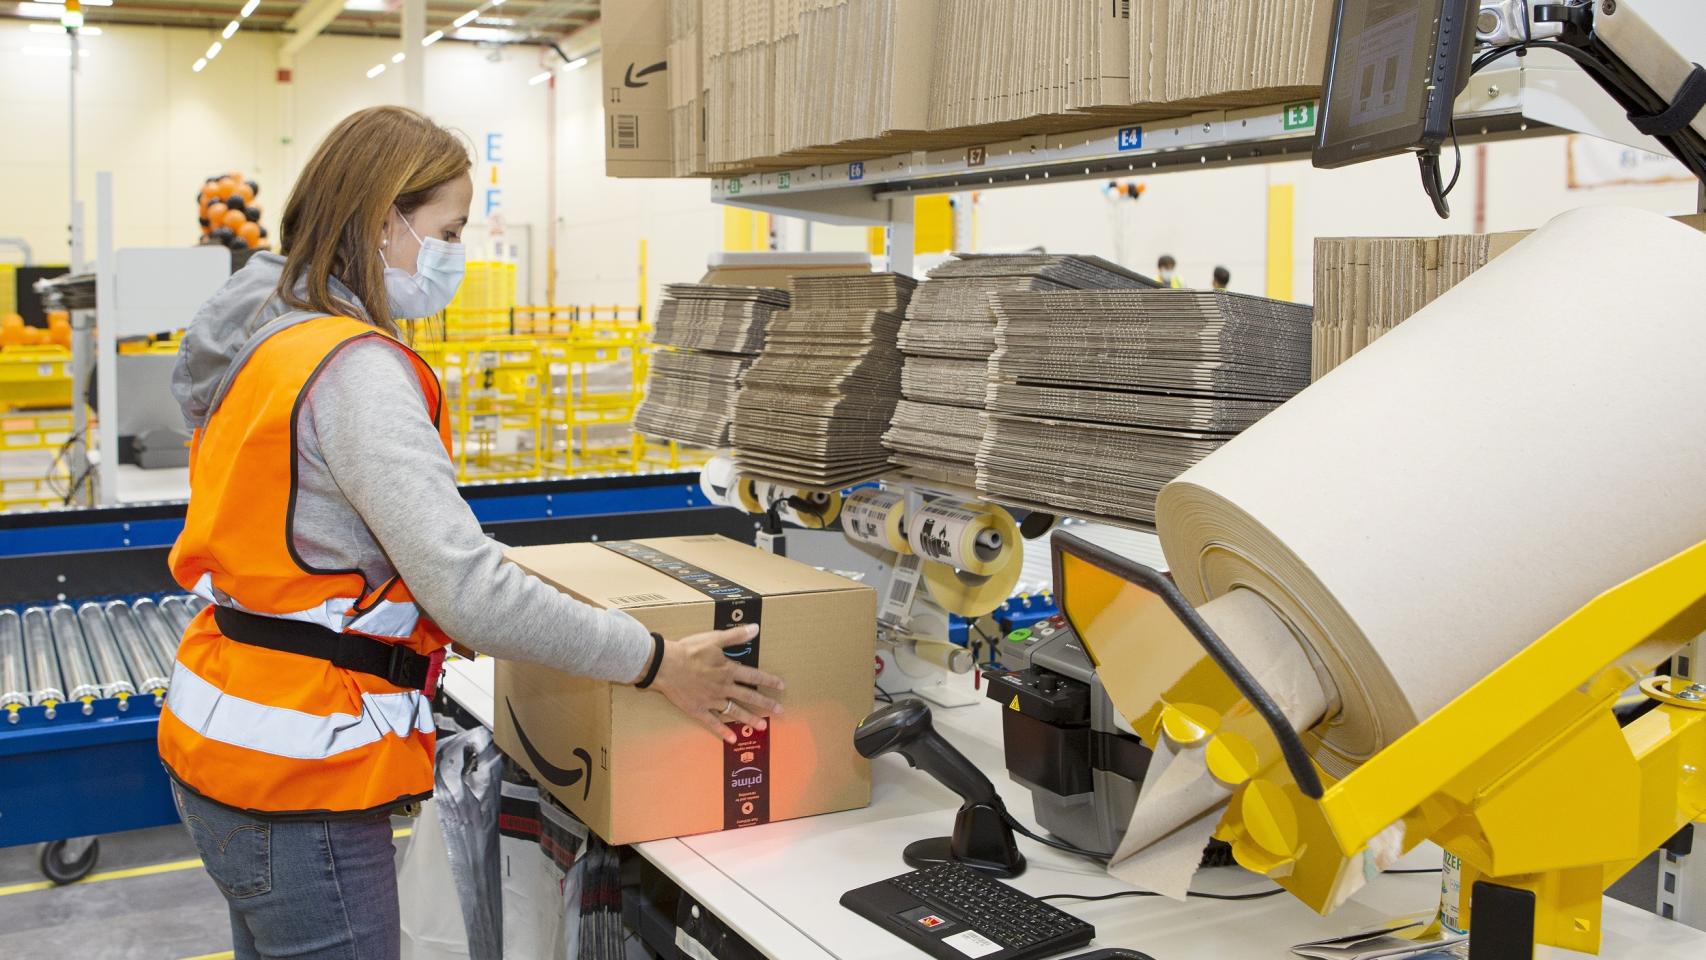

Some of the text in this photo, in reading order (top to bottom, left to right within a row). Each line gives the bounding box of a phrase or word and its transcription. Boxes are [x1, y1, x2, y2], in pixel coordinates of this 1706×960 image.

[1288, 105, 1309, 126] E3
[1121, 128, 1138, 147] E4
[969, 148, 982, 165] E7
[850, 163, 862, 178] E6
[731, 773, 763, 788] prime
